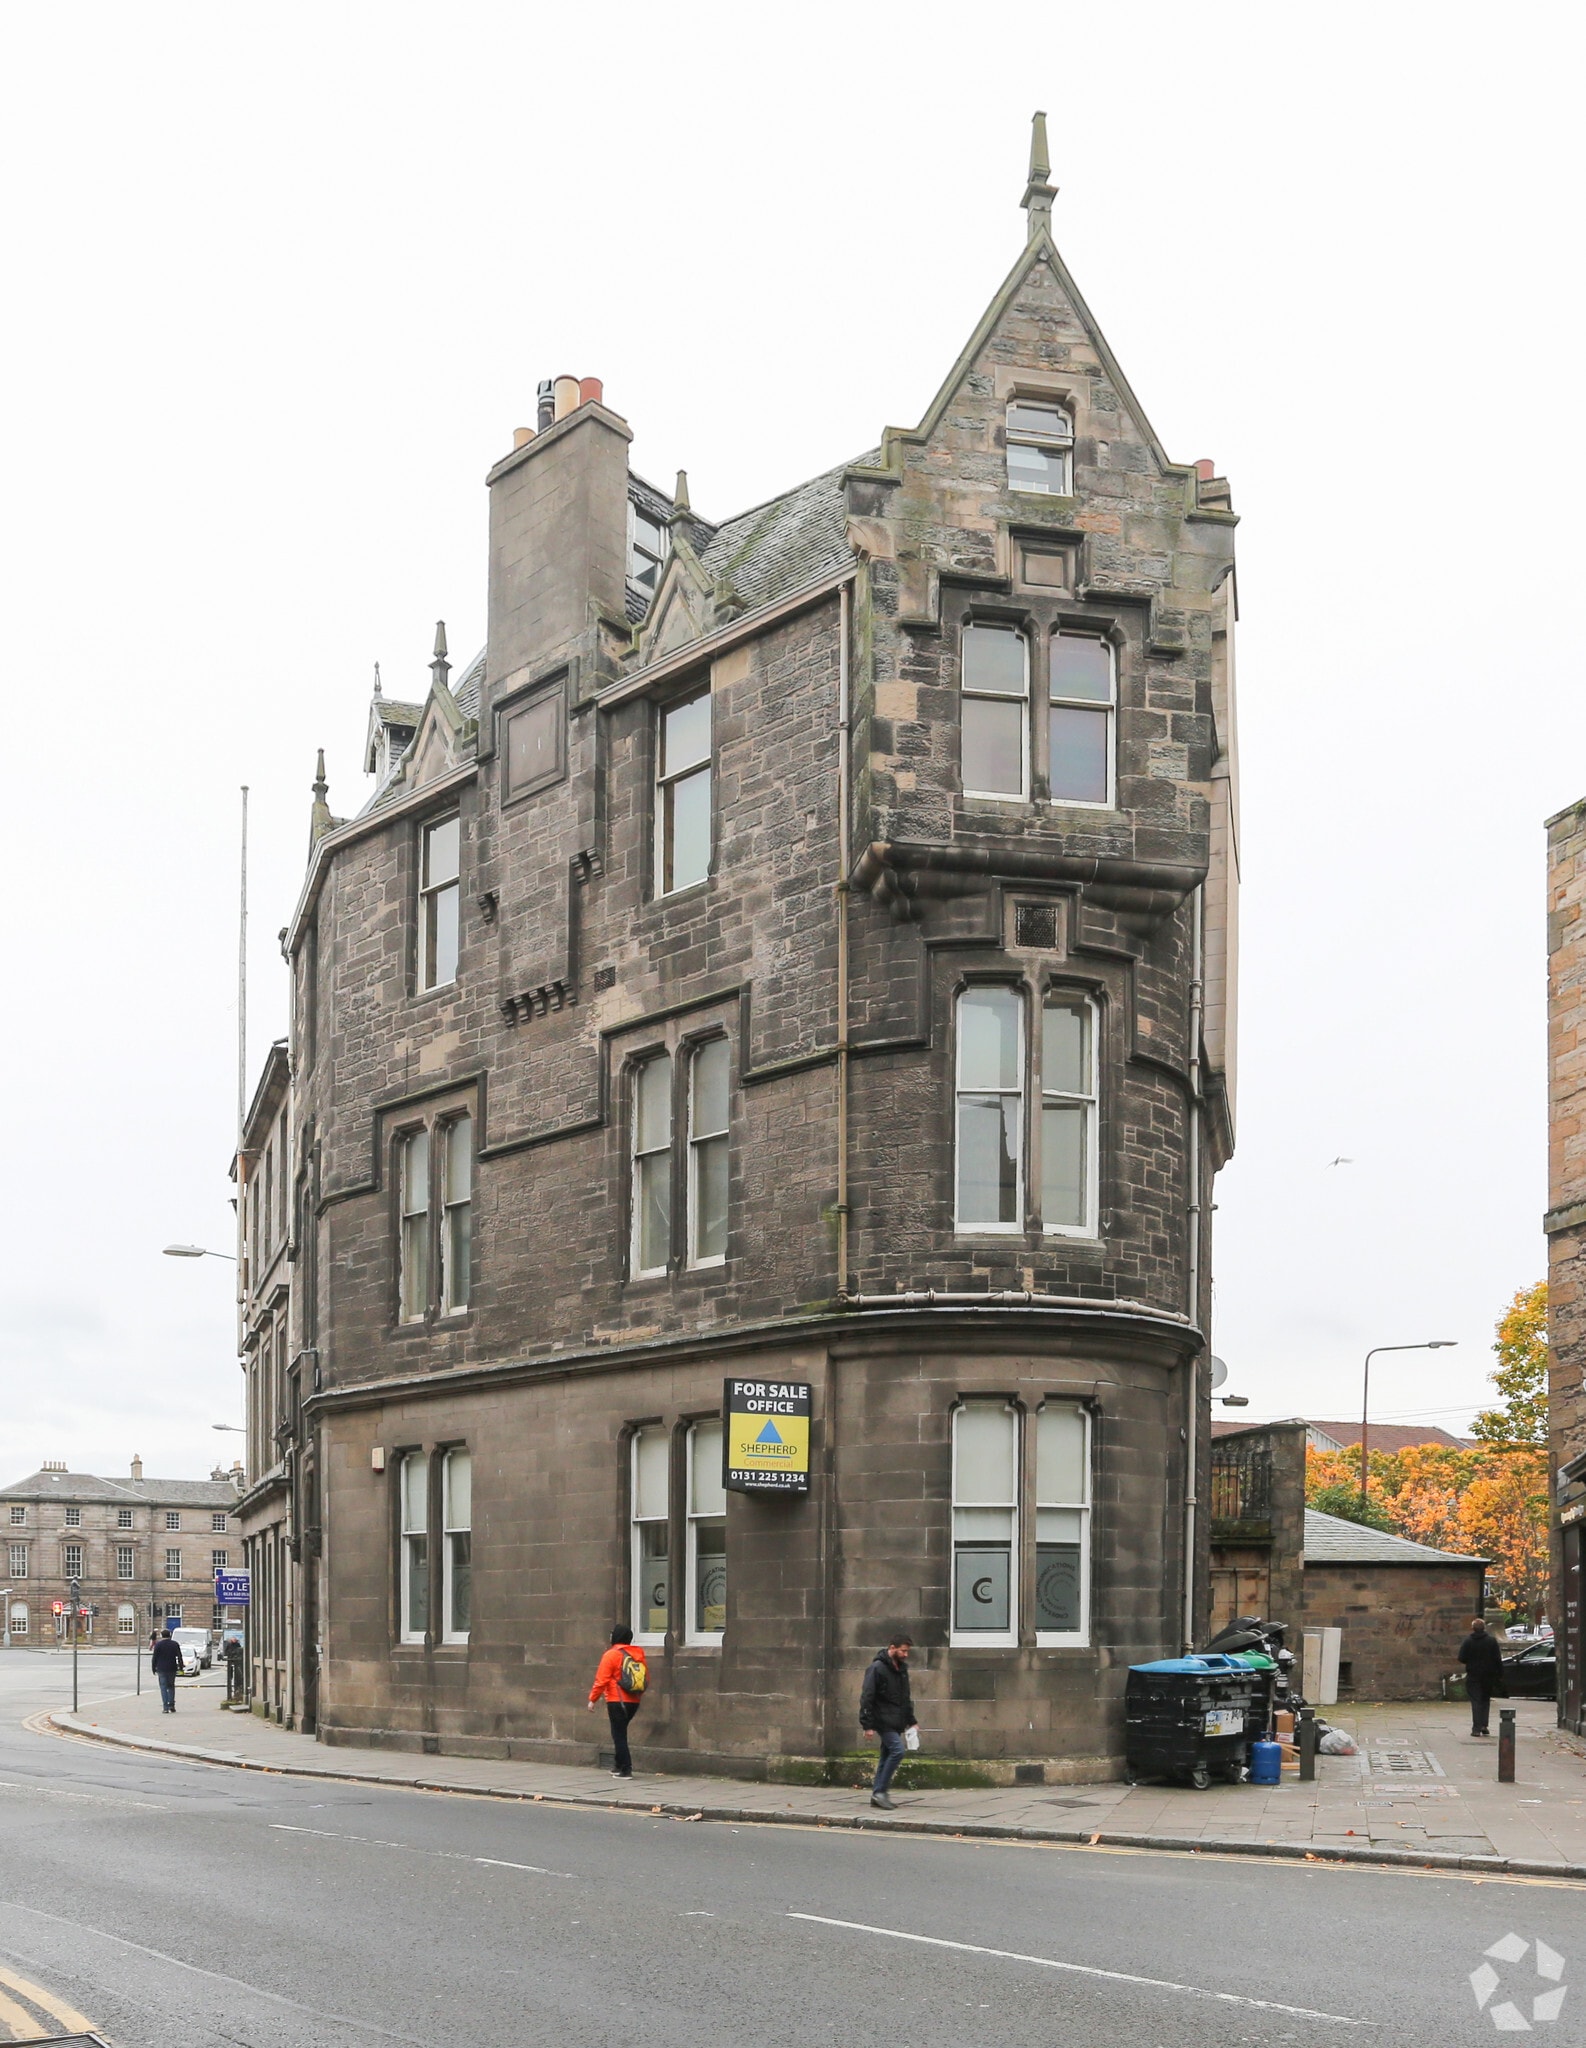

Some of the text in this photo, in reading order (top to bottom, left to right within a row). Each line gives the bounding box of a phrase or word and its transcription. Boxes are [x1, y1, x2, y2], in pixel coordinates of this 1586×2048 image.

[734, 1382, 808, 1399] FOR SALE
[747, 1400, 794, 1413] OFFICE
[740, 1443, 797, 1455] SHEPHERD
[743, 1458, 794, 1469] Commercial
[731, 1471, 805, 1483] 0131 225 1234
[221, 1582, 234, 1591] TO
